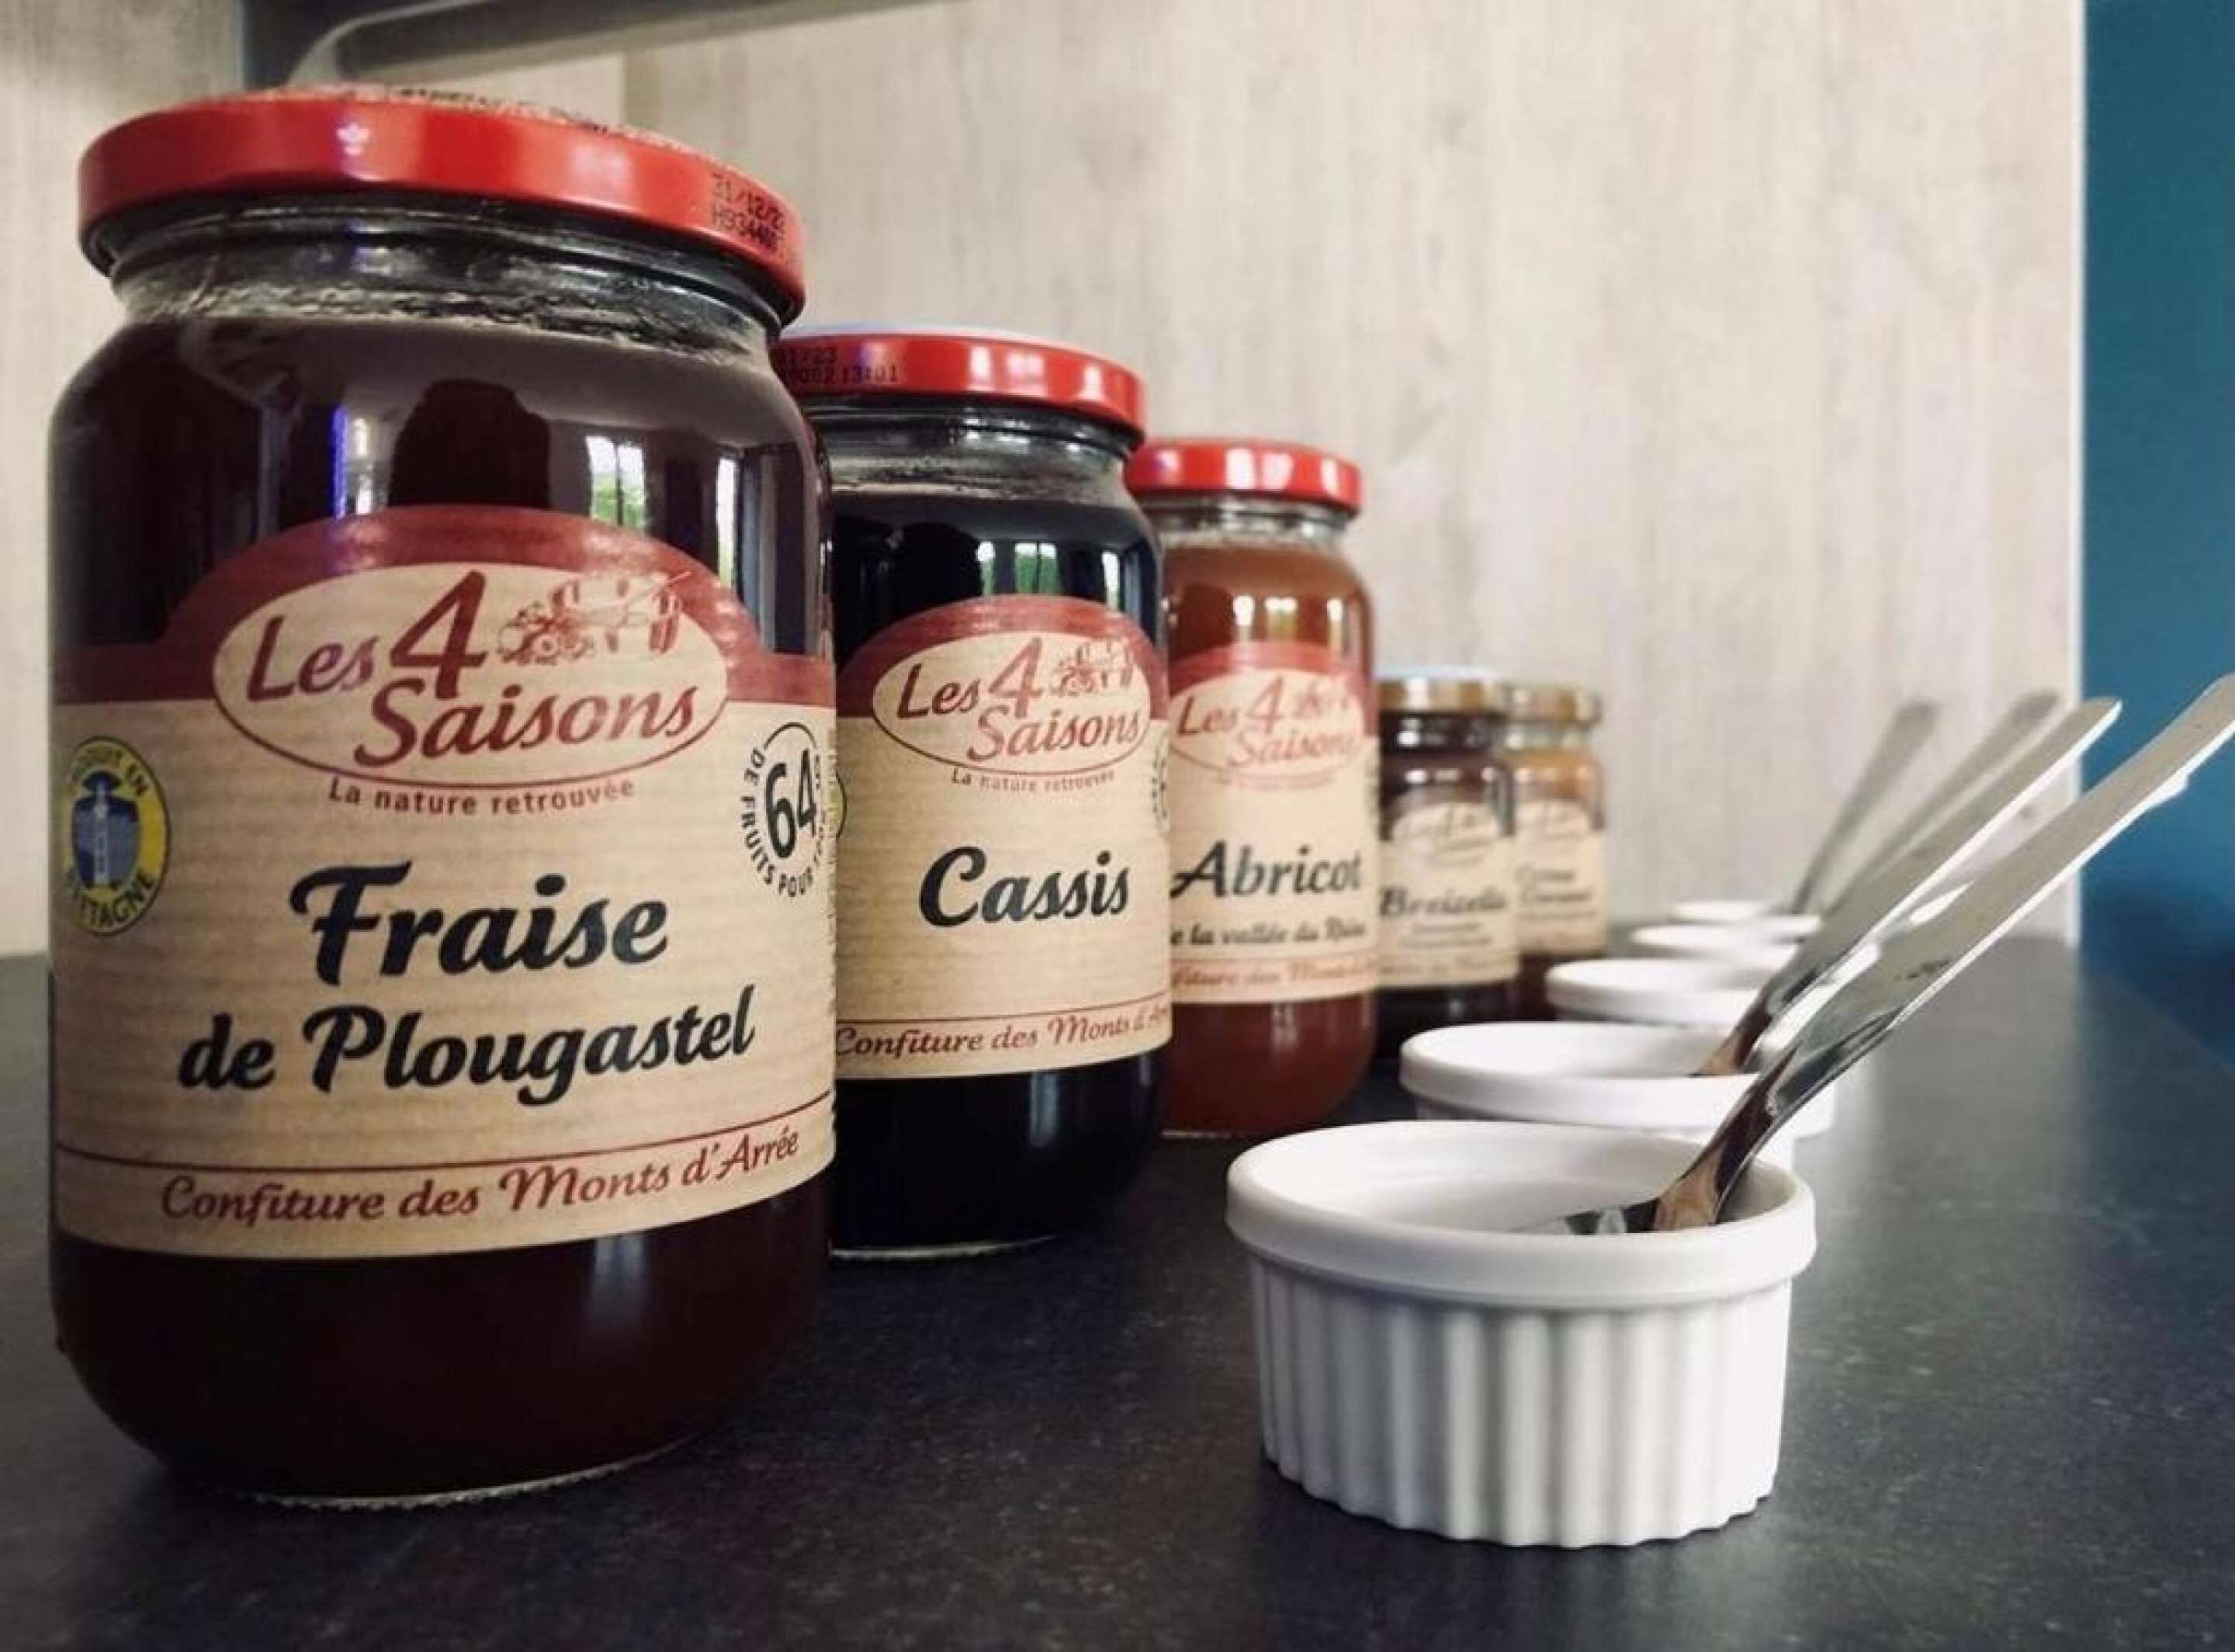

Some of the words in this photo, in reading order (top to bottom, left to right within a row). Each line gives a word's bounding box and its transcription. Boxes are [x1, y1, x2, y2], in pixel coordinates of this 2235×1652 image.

[245, 614, 377, 703] Les
[390, 570, 490, 700] 4
[896, 663, 979, 719] Les
[988, 636, 1043, 719] 4
[353, 676, 698, 768] Saisons
[968, 704, 1142, 762] Saisons
[1177, 694, 1240, 735] Les
[1245, 674, 1284, 734] 4
[328, 780, 362, 802] La
[374, 788, 476, 816] nature
[490, 778, 635, 816] retrouvée
[743, 746, 766, 786] DE
[951, 767, 971, 784] La
[740, 795, 776, 885] FRUITS
[1169, 840, 1361, 899] Abricot
[289, 859, 668, 985] Fraise
[918, 846, 1131, 928] Cassis
[178, 1013, 276, 1089] de
[303, 985, 756, 1106] Plougastel
[835, 1026, 983, 1059] Confiture
[992, 1024, 1038, 1049] des
[1047, 1012, 1129, 1045] Monts
[161, 1175, 386, 1228] Confiture
[398, 1178, 480, 1218] des
[499, 1159, 670, 1213] Monts
[681, 1126, 799, 1186] d'Arrée
